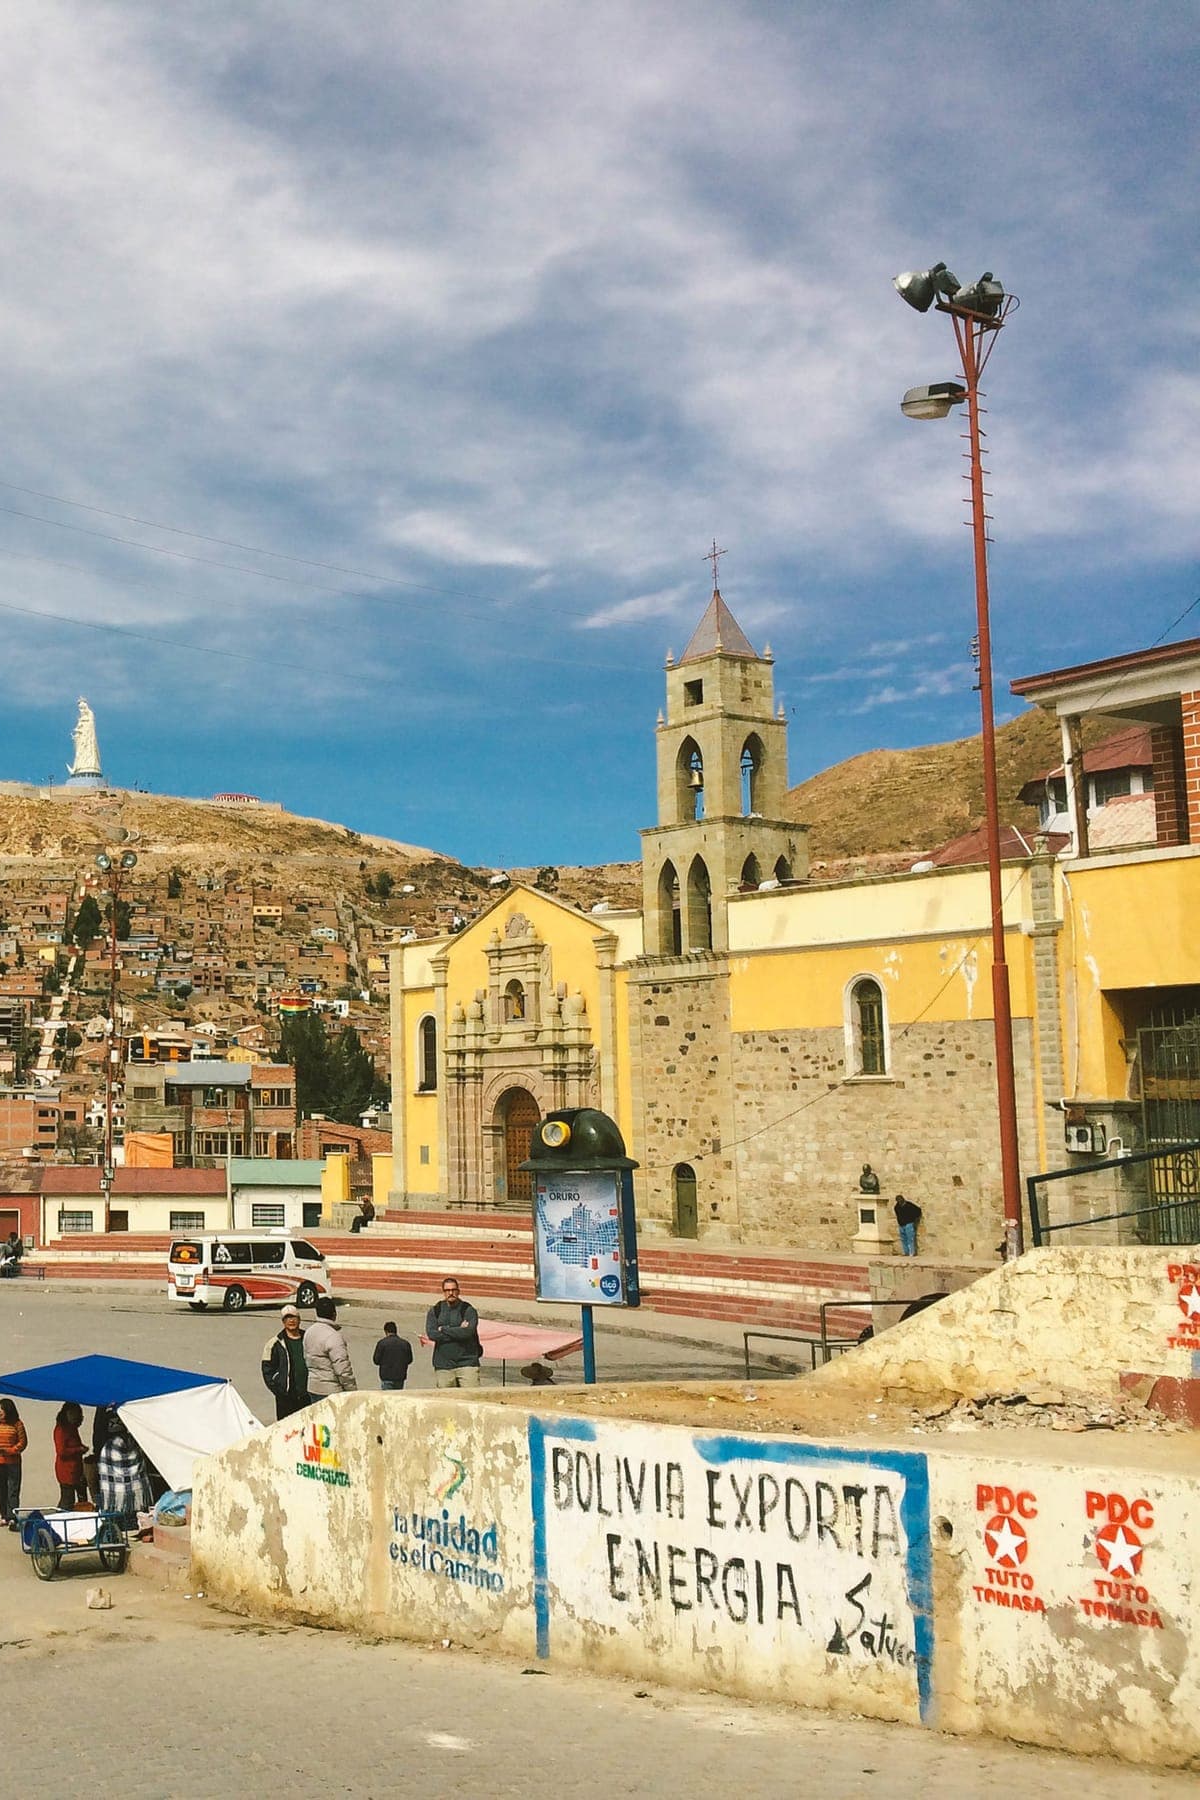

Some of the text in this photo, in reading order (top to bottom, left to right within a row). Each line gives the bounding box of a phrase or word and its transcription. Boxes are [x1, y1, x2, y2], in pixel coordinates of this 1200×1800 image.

[549, 1192, 580, 1201] ORURO
[601, 1279, 617, 1292] tigo
[1167, 1264, 1200, 1283] PD
[1178, 1323, 1200, 1335] TU
[552, 1447, 901, 1559] BOLIVIA EXPORTA
[976, 1484, 1038, 1520] PDC
[1085, 1490, 1154, 1529] PDC
[394, 1507, 498, 1563] la unidad
[390, 1542, 505, 1593] es el Camino
[606, 1533, 802, 1626] ENERGIA
[984, 1567, 1034, 1591] TUTO
[972, 1585, 1046, 1614] TOMASA
[1094, 1579, 1149, 1604] TUTO
[1080, 1598, 1164, 1630] TOMASA
